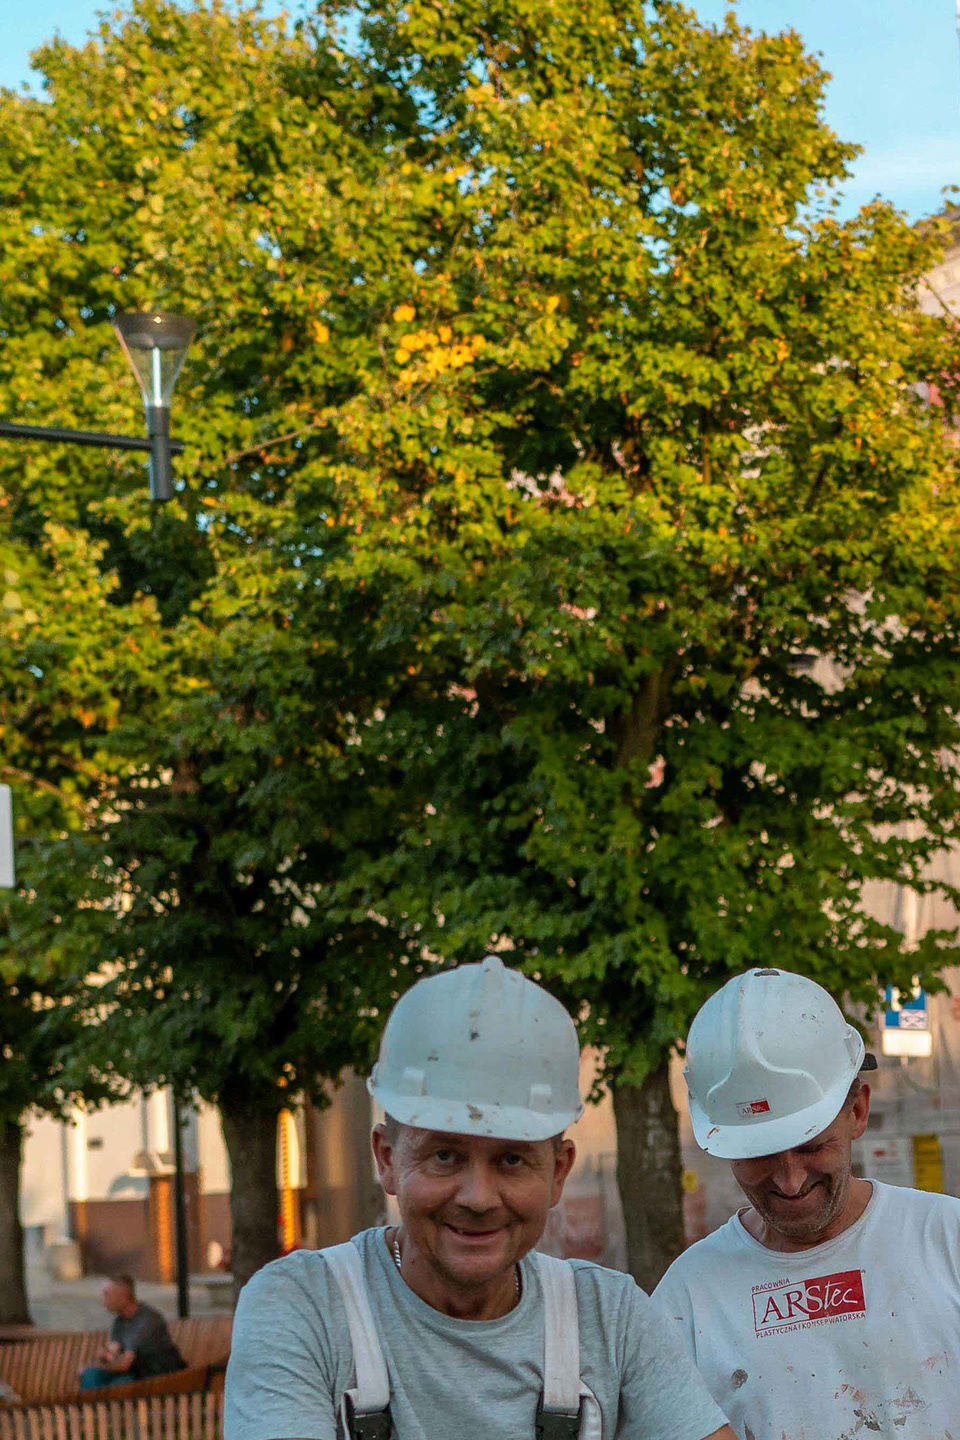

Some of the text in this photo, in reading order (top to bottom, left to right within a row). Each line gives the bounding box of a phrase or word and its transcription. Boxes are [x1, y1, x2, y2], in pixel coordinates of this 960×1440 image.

[751, 1277, 790, 1293] PRACOWNIA
[761, 1281, 858, 1324] ARStec
[756, 1325, 798, 1339] PLASTYCZNA
[802, 1312, 866, 1330] KONSERWATORSKA
